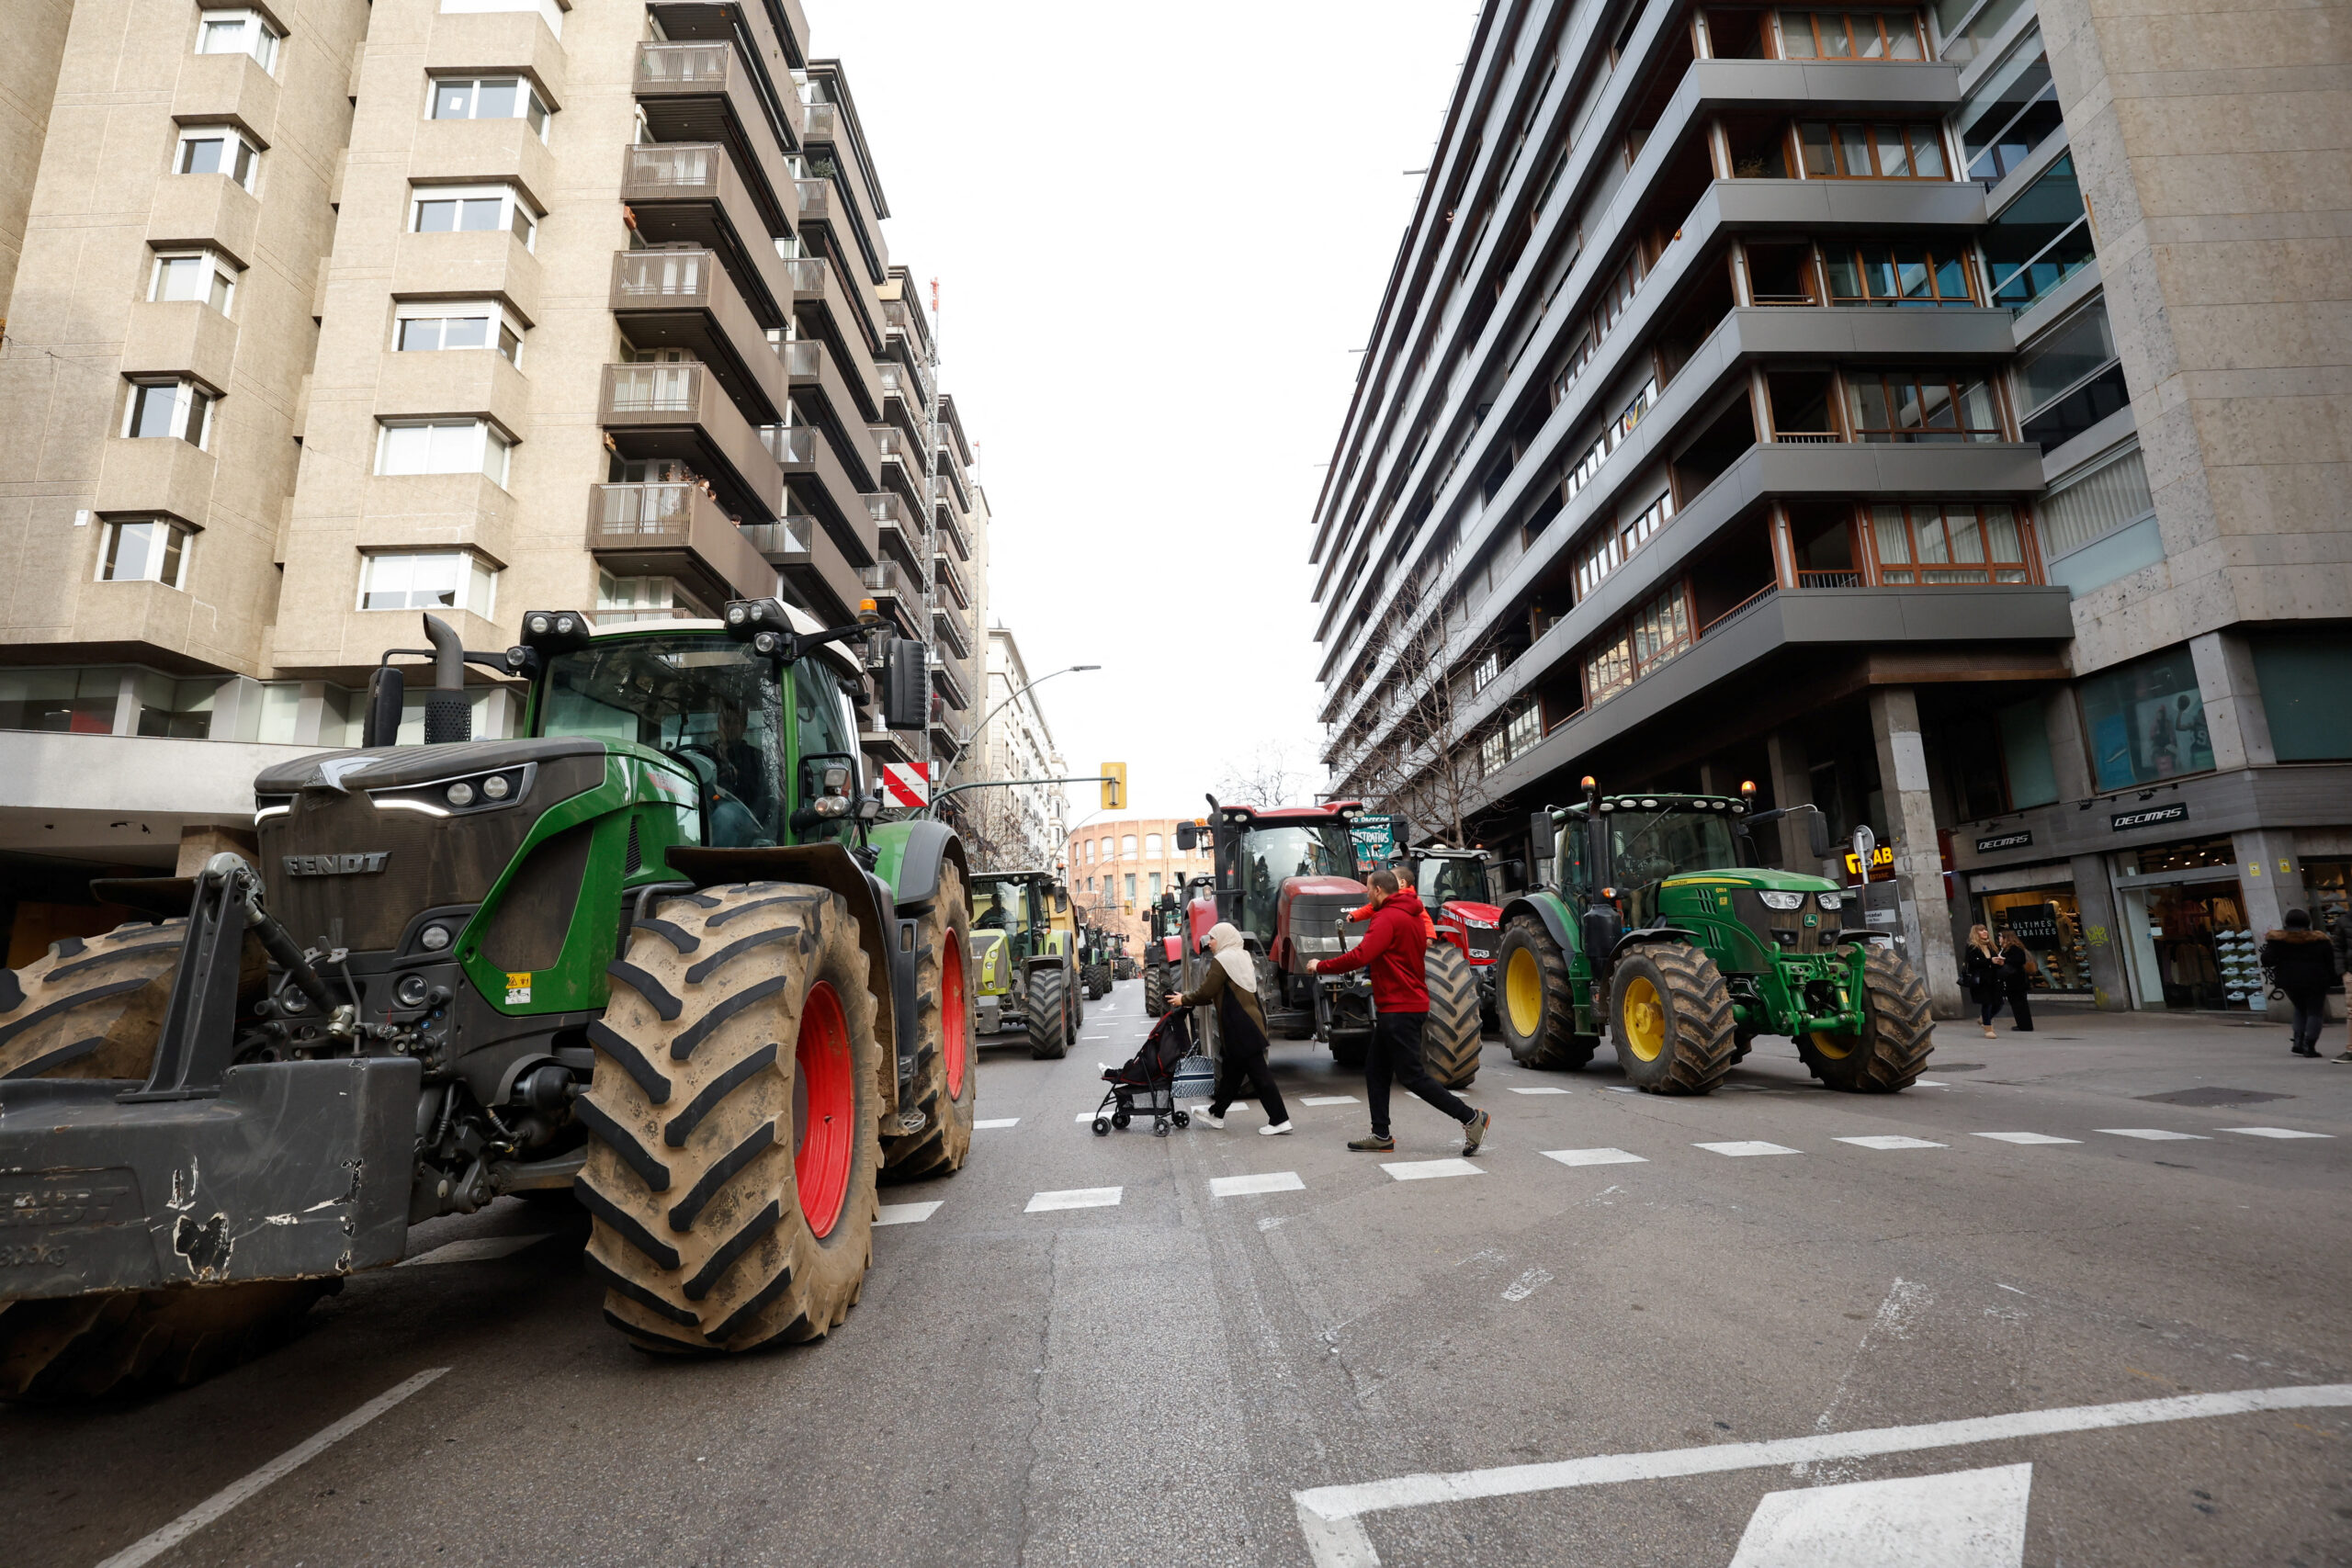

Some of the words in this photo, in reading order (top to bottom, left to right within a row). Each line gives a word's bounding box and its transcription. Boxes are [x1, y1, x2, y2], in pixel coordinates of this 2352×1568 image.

[2114, 807, 2183, 828] DECIMAS
[1978, 834, 2029, 851] DECIMAS
[282, 851, 392, 875] FENDT
[2017, 928, 2057, 937] EBAIXES
